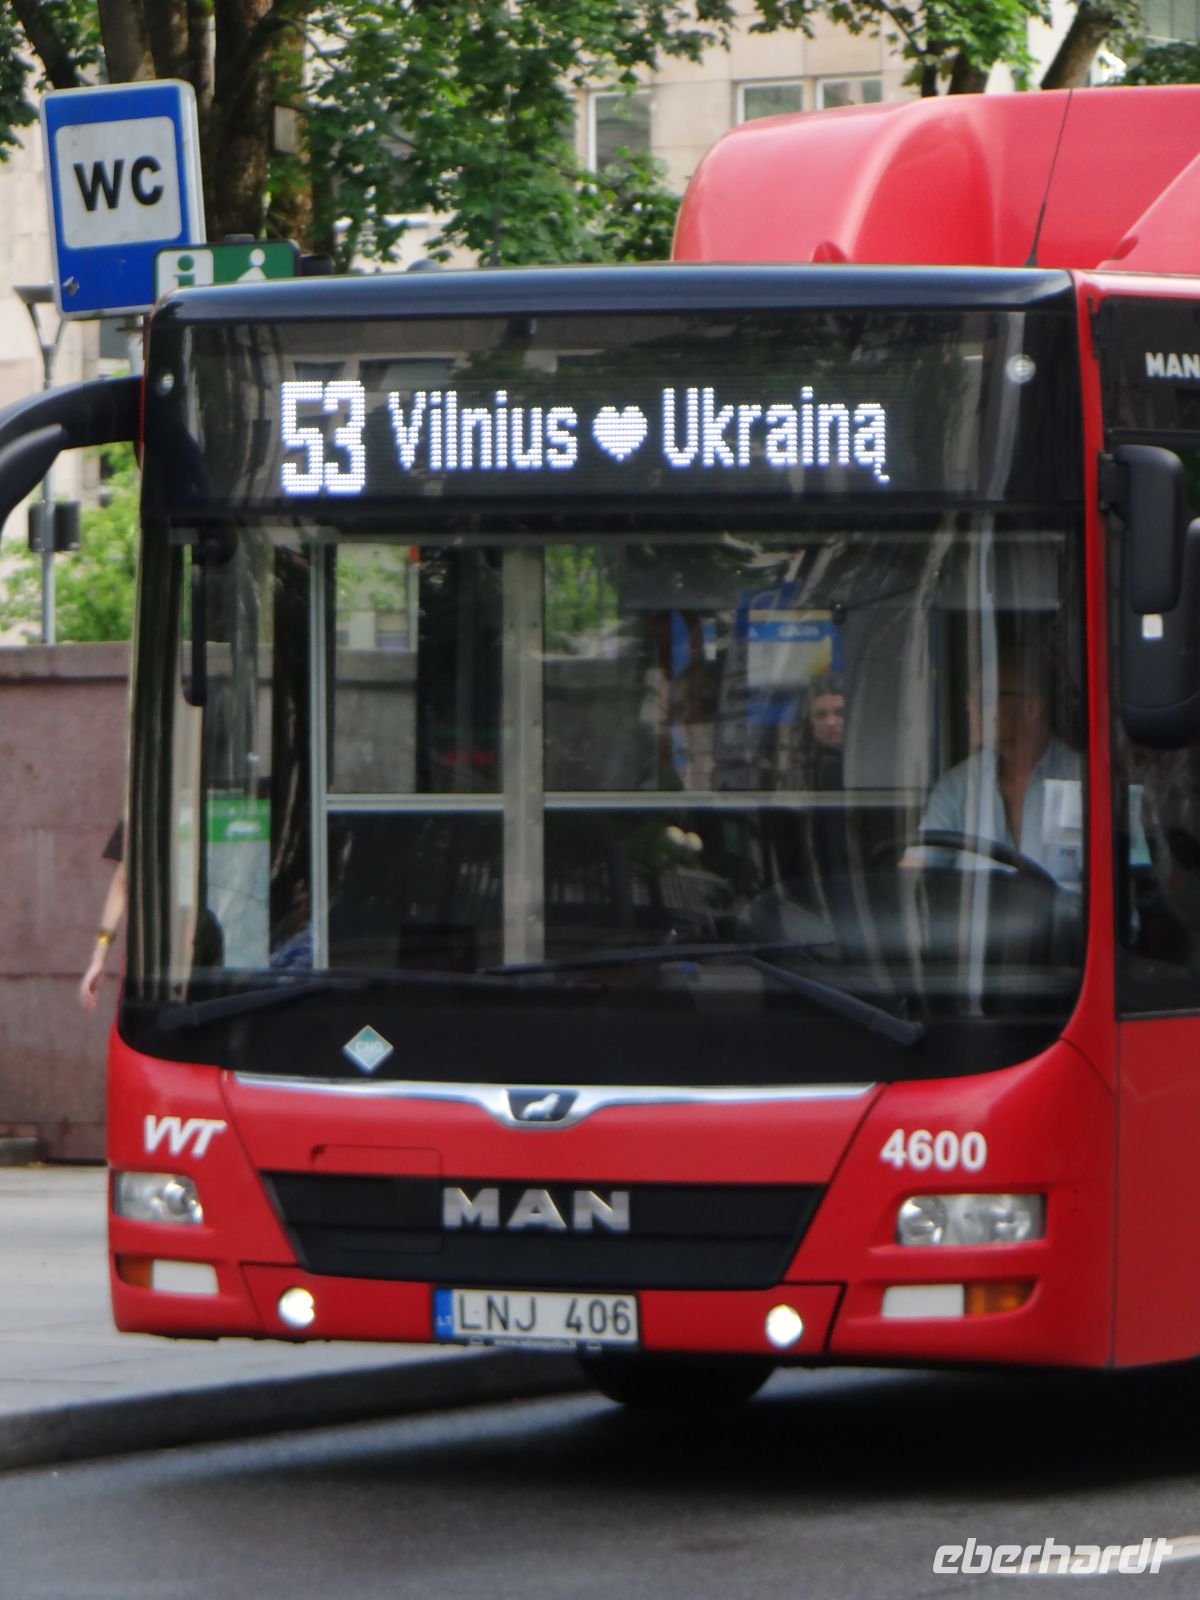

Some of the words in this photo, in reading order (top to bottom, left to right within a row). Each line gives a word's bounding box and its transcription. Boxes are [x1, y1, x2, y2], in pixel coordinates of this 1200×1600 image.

[73, 155, 164, 212] WC
[1145, 351, 1200, 378] MAN
[281, 380, 366, 496] 53
[388, 390, 578, 471] Vilnius
[662, 386, 889, 485] Ukrainą
[880, 1128, 987, 1172] 4600
[442, 1186, 630, 1232] MAN
[459, 1293, 536, 1332] LNJ
[565, 1297, 631, 1335] 406
